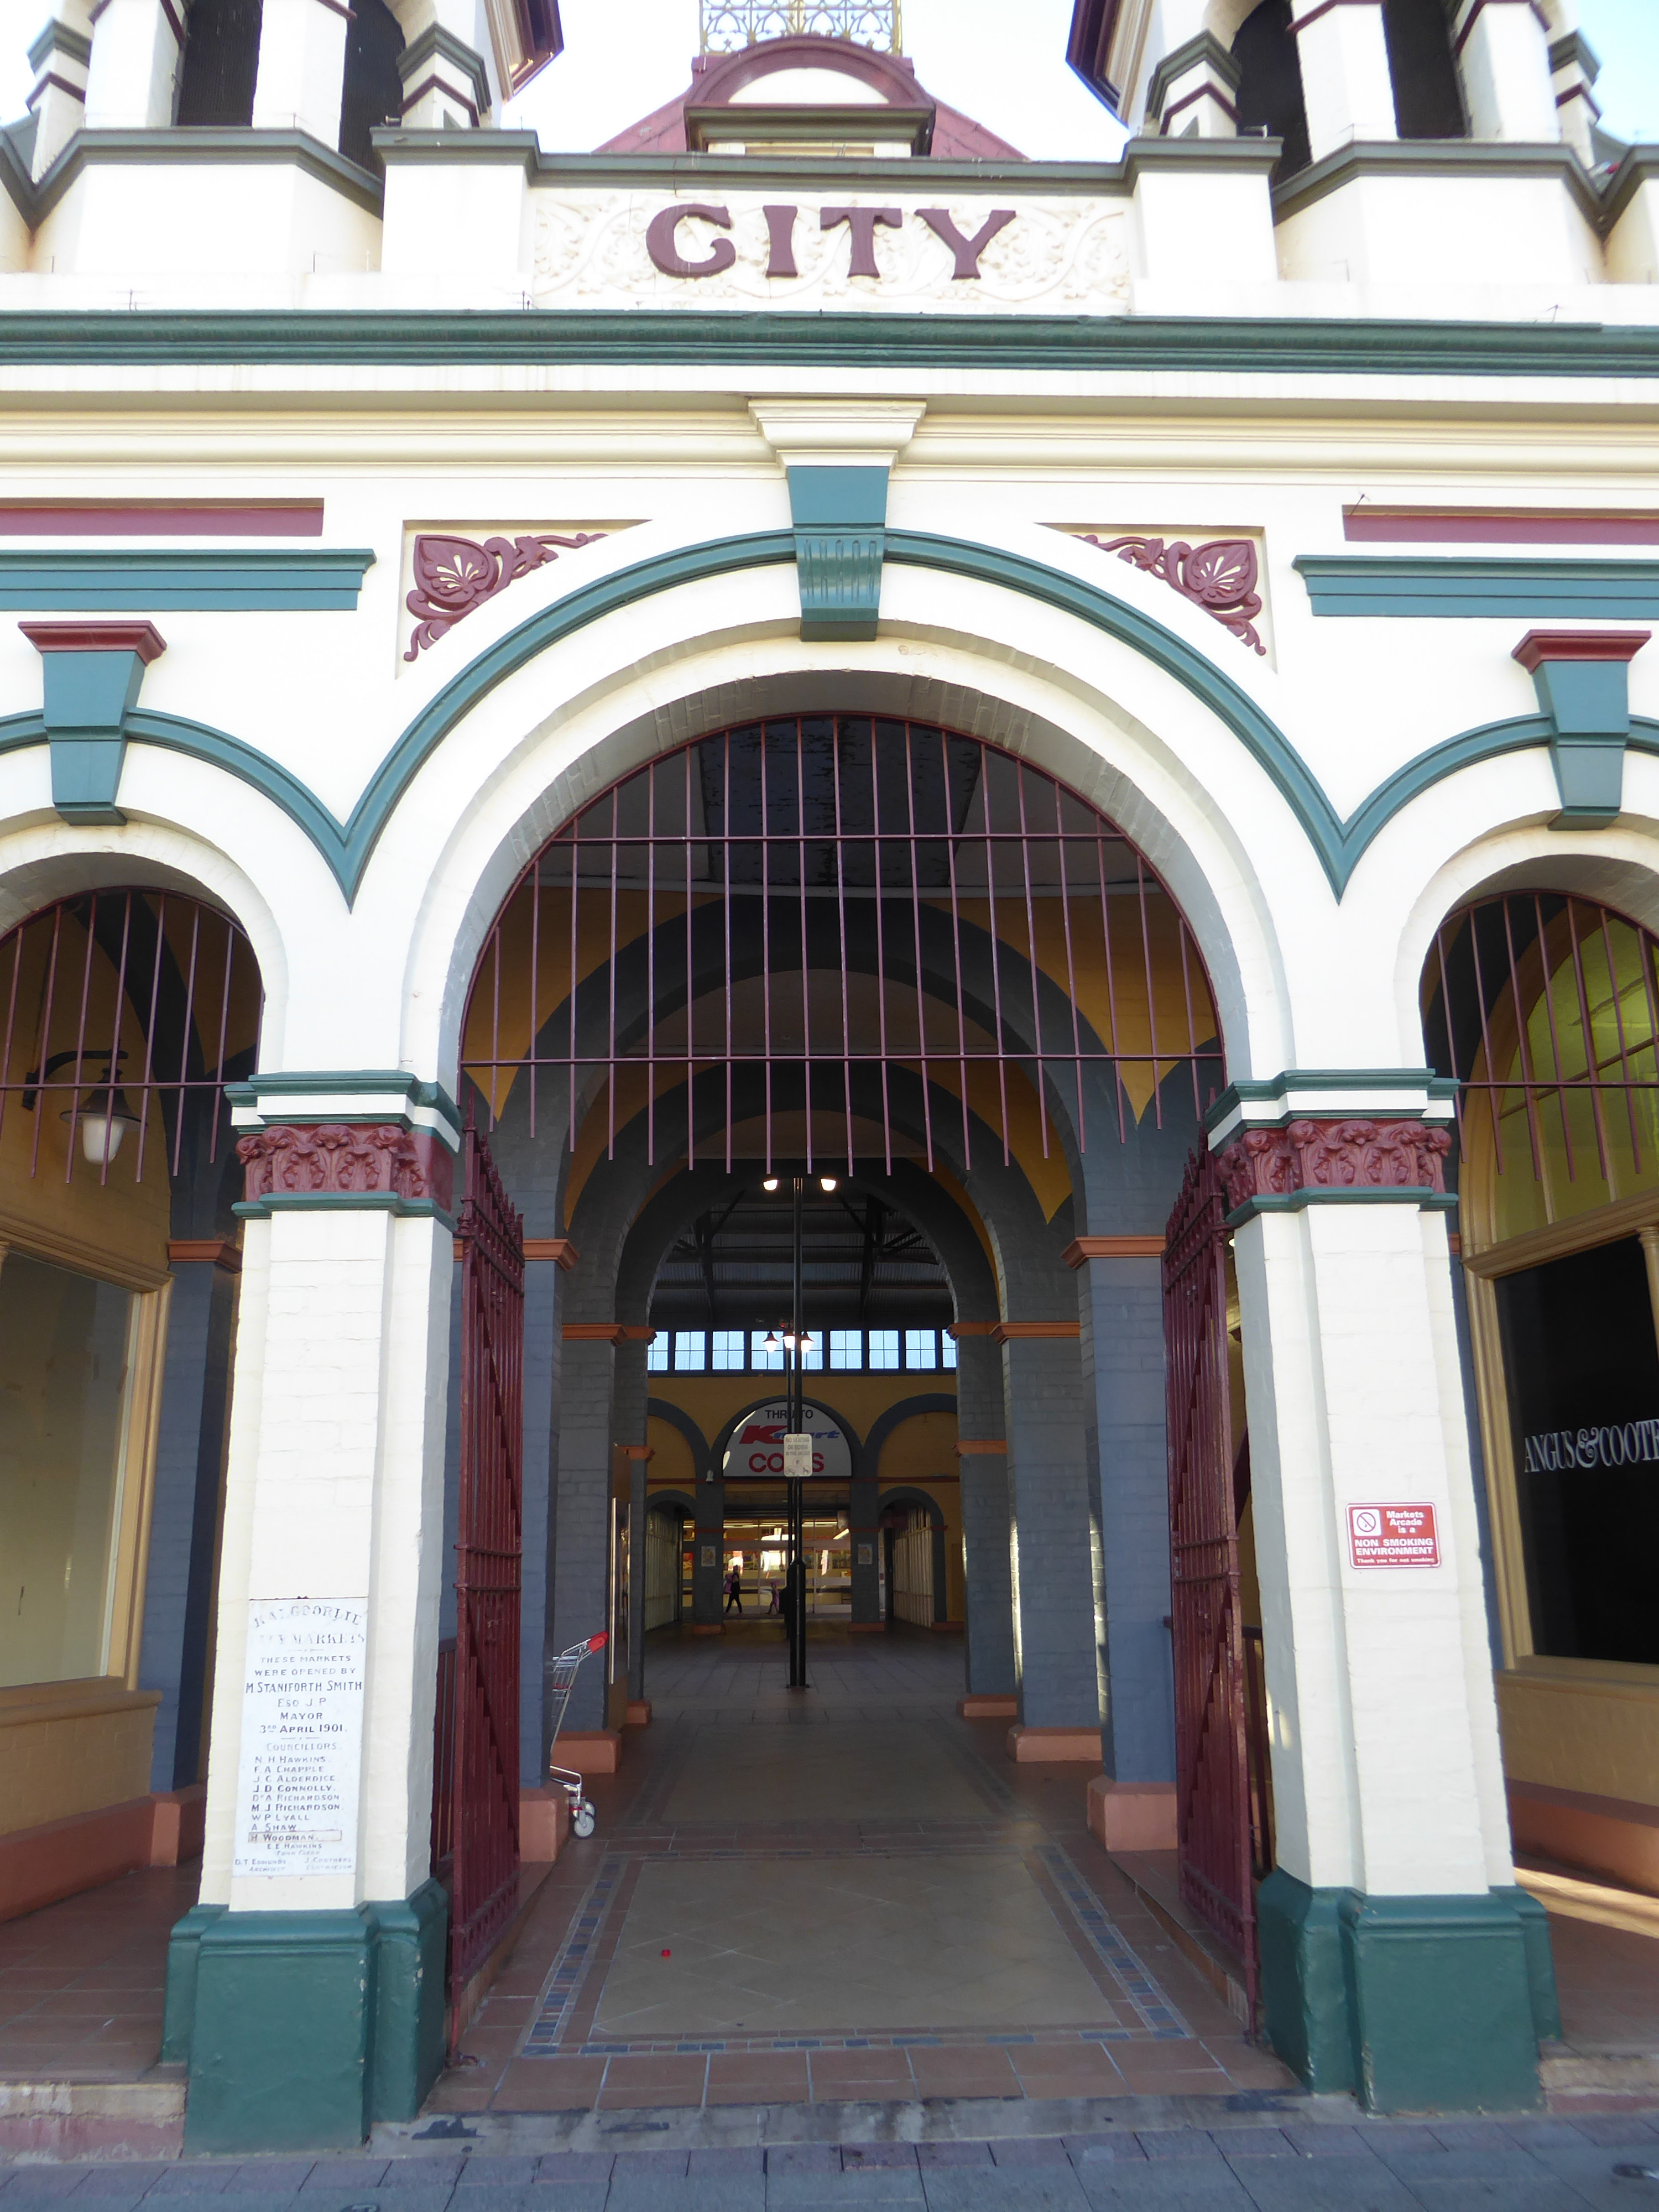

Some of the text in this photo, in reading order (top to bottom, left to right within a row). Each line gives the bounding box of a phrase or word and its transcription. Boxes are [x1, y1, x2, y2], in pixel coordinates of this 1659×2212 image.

[645, 204, 1016, 280] CITY
[765, 1410, 795, 1420] THR
[739, 1425, 840, 1444] Krt
[749, 1453, 825, 1473] COS
[1386, 1510, 1425, 1519] Markets
[1354, 1538, 1433, 1547] NON SMOKING
[1355, 1547, 1433, 1556] ENVIRONMENT
[291, 1668, 336, 1676] OPENED
[257, 1682, 322, 1693] STANIFORTH
[326, 1680, 363, 1692] SMITH
[280, 1712, 323, 1720] MAYOR
[279, 1725, 315, 1733] APRIL
